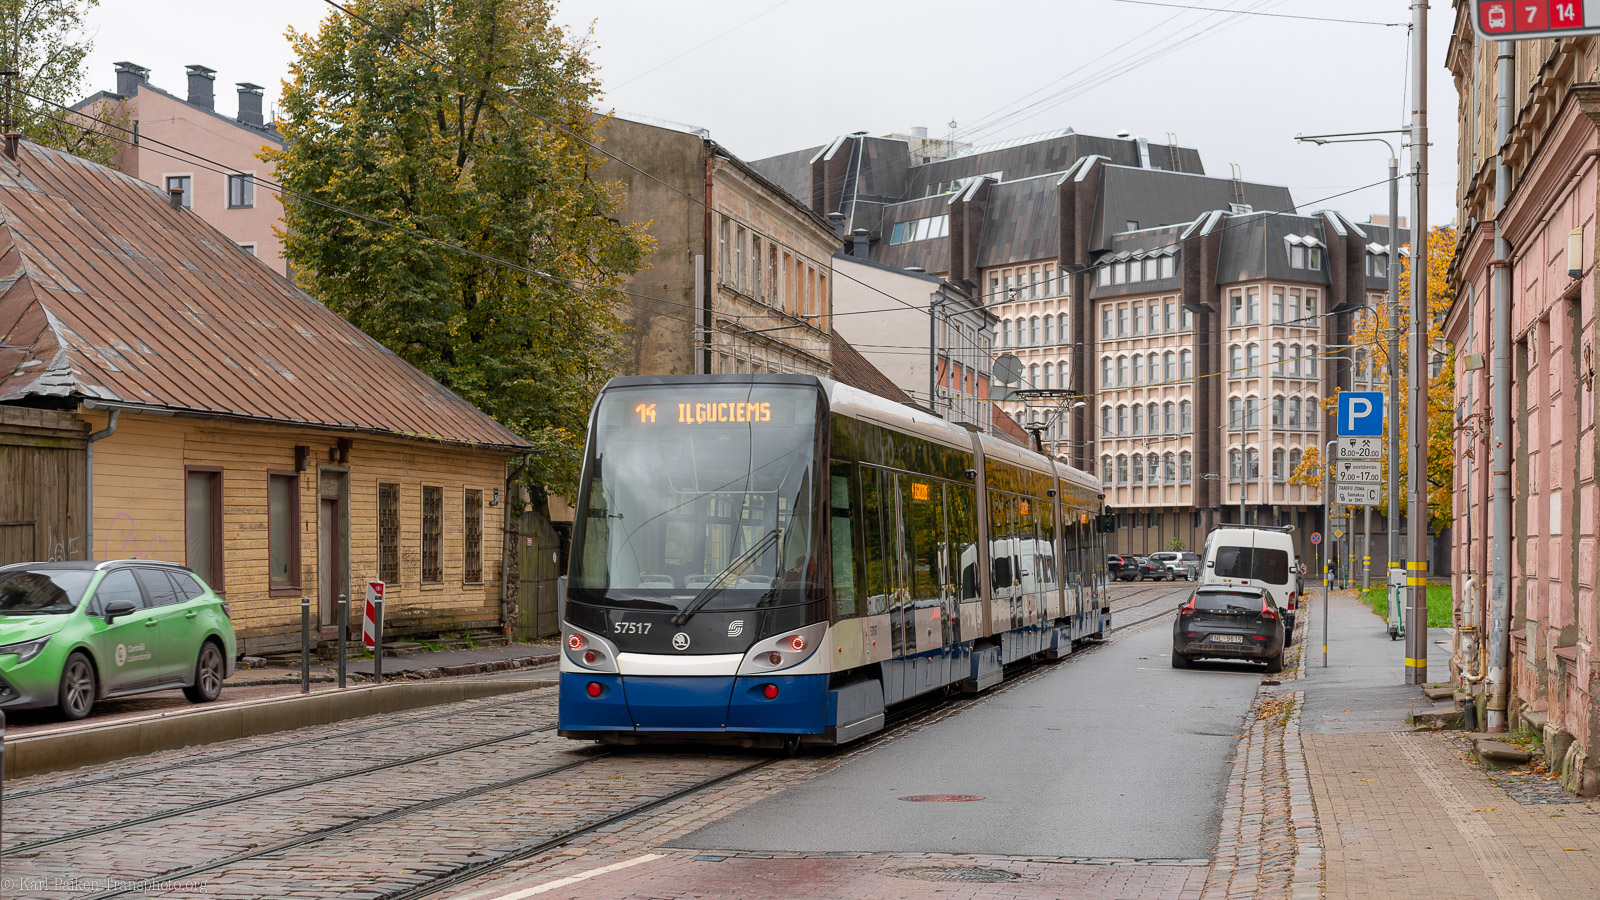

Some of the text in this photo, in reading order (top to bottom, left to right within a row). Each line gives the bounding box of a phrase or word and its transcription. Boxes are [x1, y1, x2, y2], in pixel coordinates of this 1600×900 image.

[1525, 3, 1575, 23] 7 14
[635, 402, 771, 425] 14 IĻĢUCIEMS
[1348, 397, 1373, 431] P
[1369, 489, 1376, 500] C
[614, 621, 652, 635] 57517
